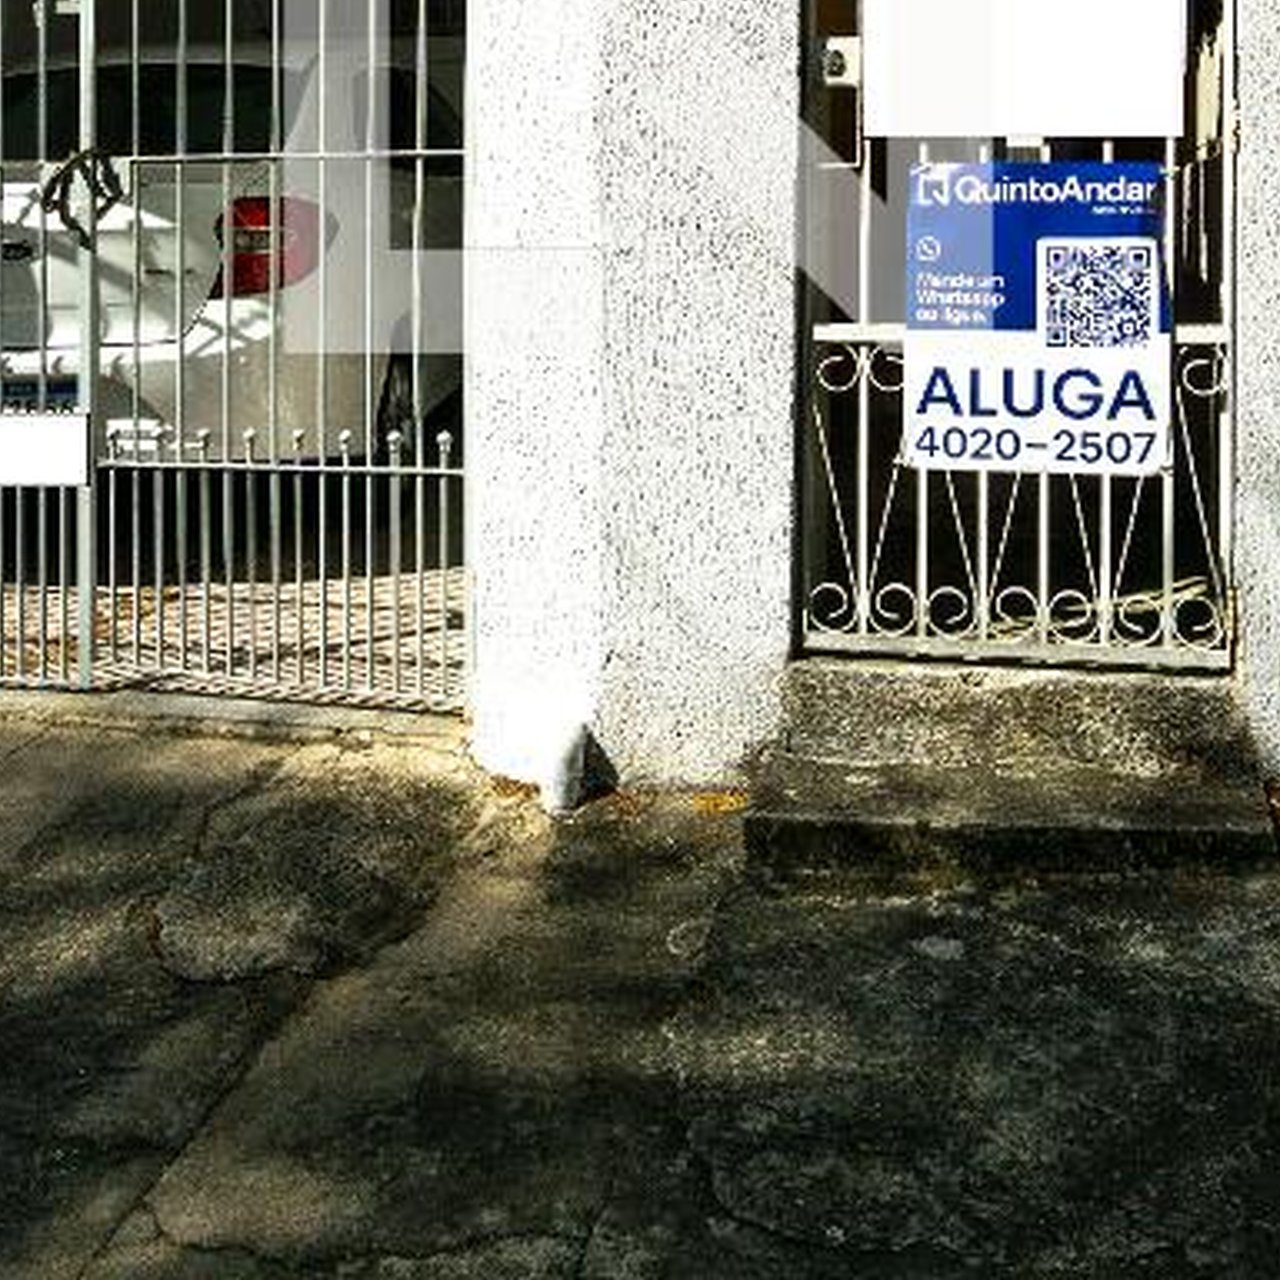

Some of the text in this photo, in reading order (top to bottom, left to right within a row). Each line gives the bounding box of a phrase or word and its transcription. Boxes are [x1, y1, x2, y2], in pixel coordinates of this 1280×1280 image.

[954, 176, 1157, 204] QuintoAndar
[916, 367, 1156, 420] ALUGA
[915, 426, 1157, 464] 4020-2507
